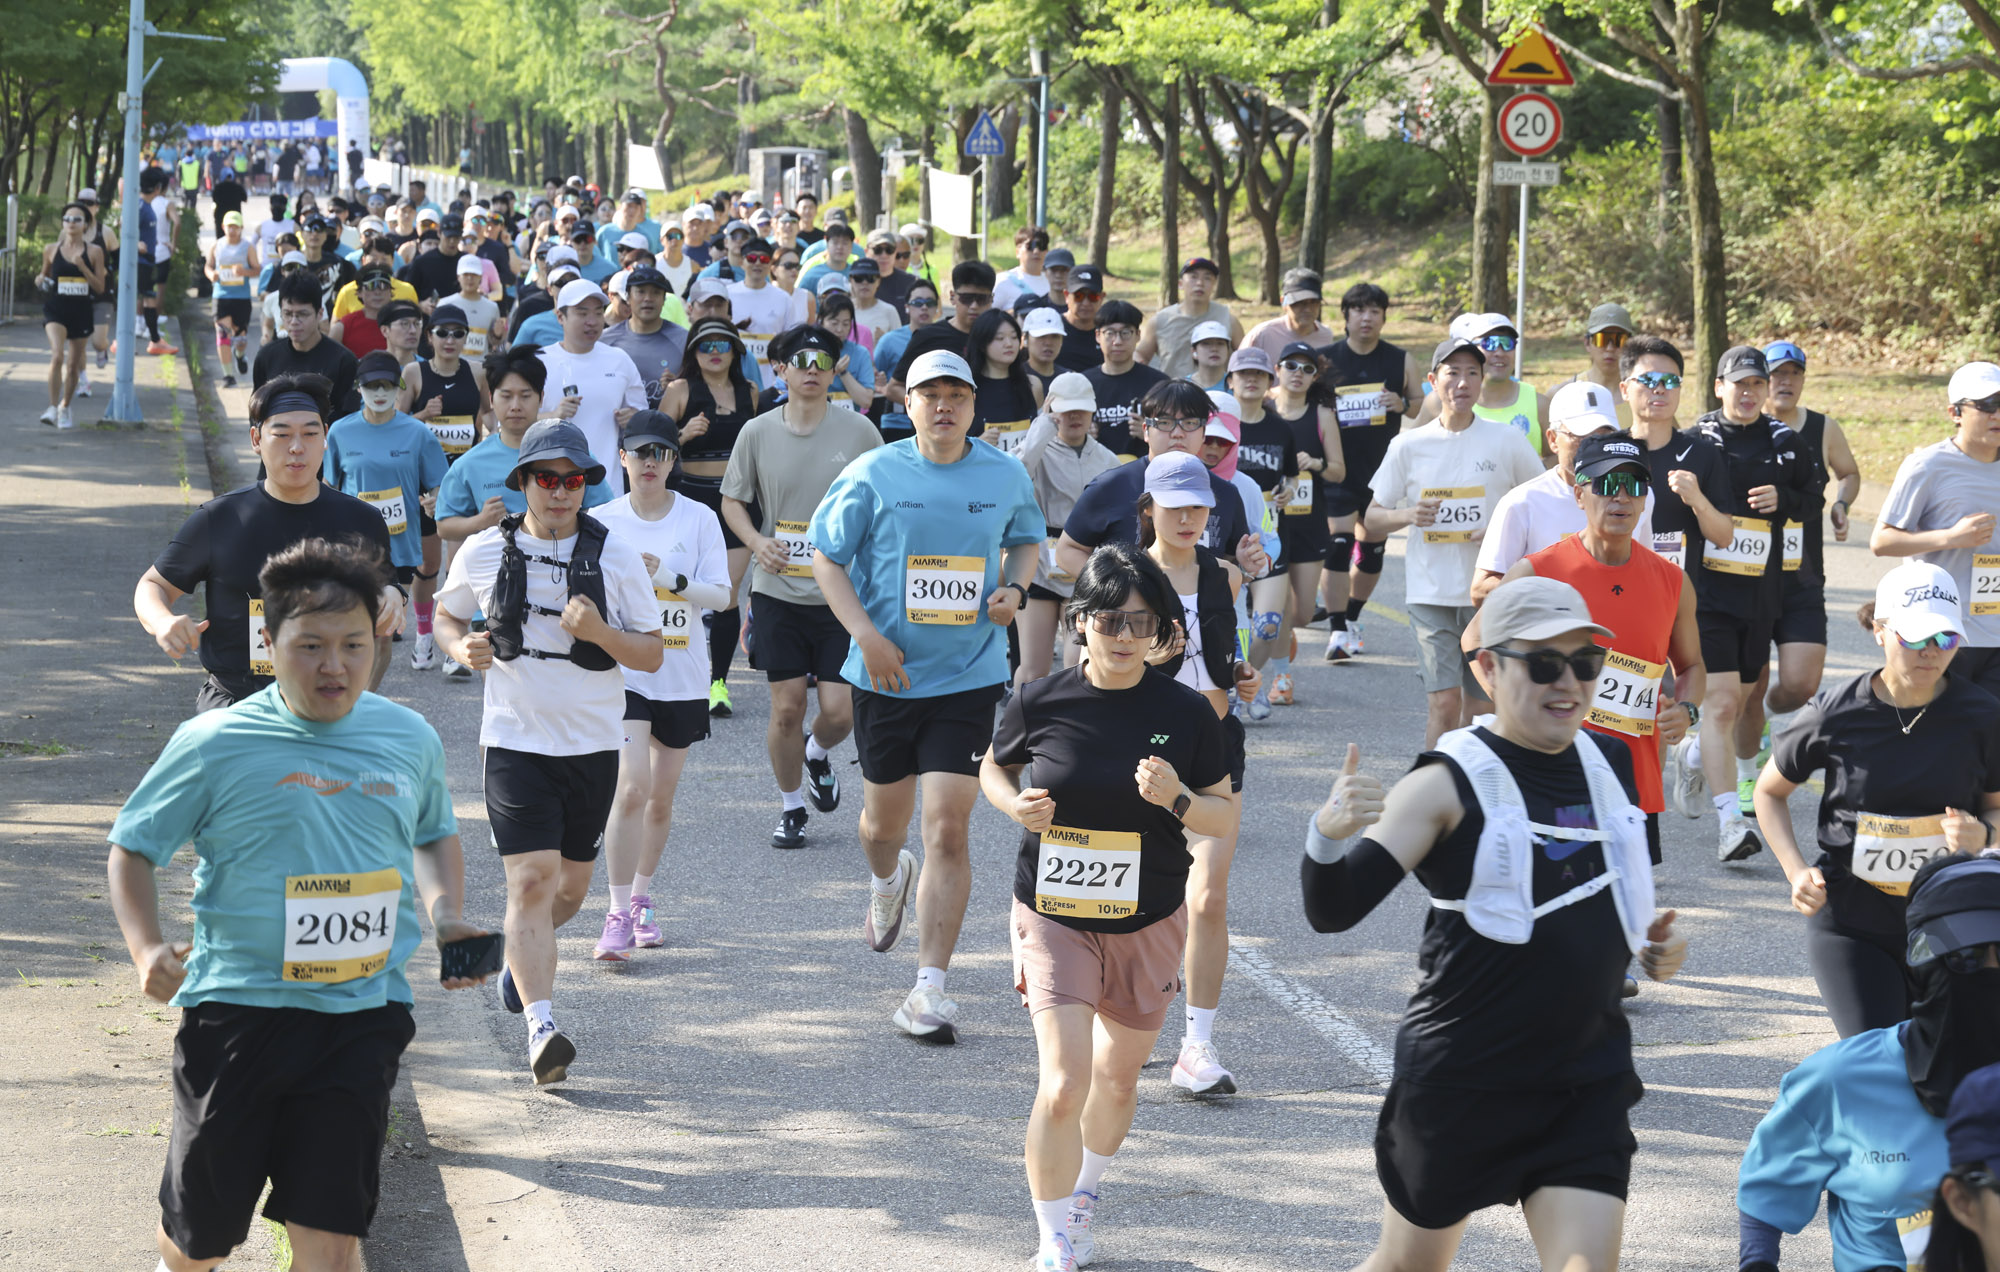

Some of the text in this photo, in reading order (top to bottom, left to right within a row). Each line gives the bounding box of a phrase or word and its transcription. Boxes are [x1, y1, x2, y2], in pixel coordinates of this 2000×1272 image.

[1514, 112, 1547, 137] 20
[1497, 167, 1526, 180] 30m
[1603, 444, 1640, 456] OUTBACK
[912, 558, 948, 569] 시사저널
[911, 578, 977, 601] 3008
[955, 613, 964, 621] 10
[1608, 654, 1647, 674] 시사저널
[1598, 677, 1654, 709] 2164
[1636, 722, 1644, 731] 10
[1047, 829, 1090, 846] 시사저널
[1044, 856, 1132, 888] 2227
[294, 879, 351, 894] 시사저널
[1098, 904, 1111, 915] 10
[1112, 904, 1131, 915] km
[295, 906, 389, 946] 2084
